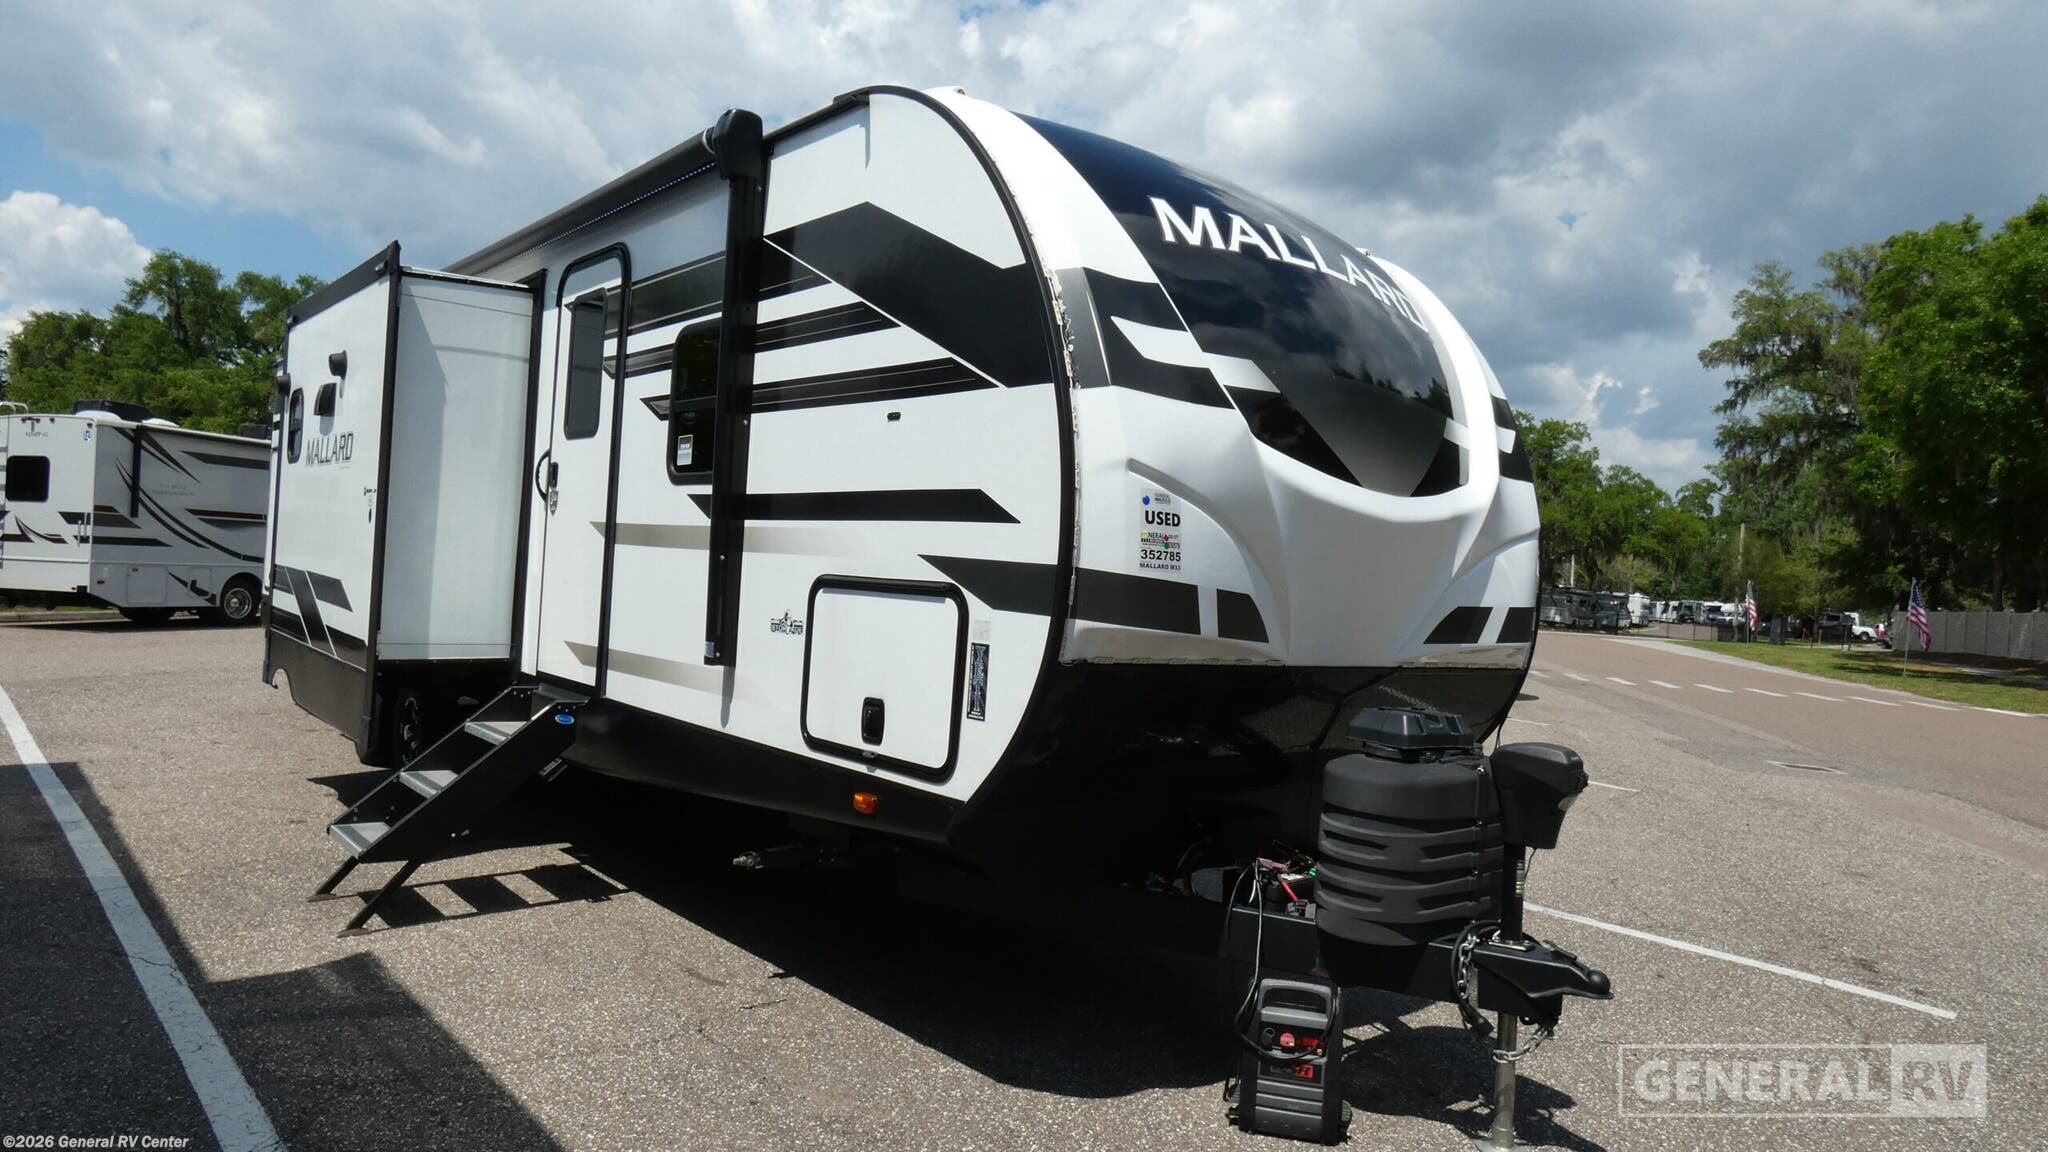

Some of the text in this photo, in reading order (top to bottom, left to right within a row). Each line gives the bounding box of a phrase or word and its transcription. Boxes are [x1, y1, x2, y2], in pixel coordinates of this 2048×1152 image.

[1149, 196, 1430, 333] MALLARD
[305, 431, 354, 466] MALLARD
[1145, 510, 1181, 527] USED
[1140, 549, 1181, 562] 352785
[1139, 562, 1169, 570] MALLARD
